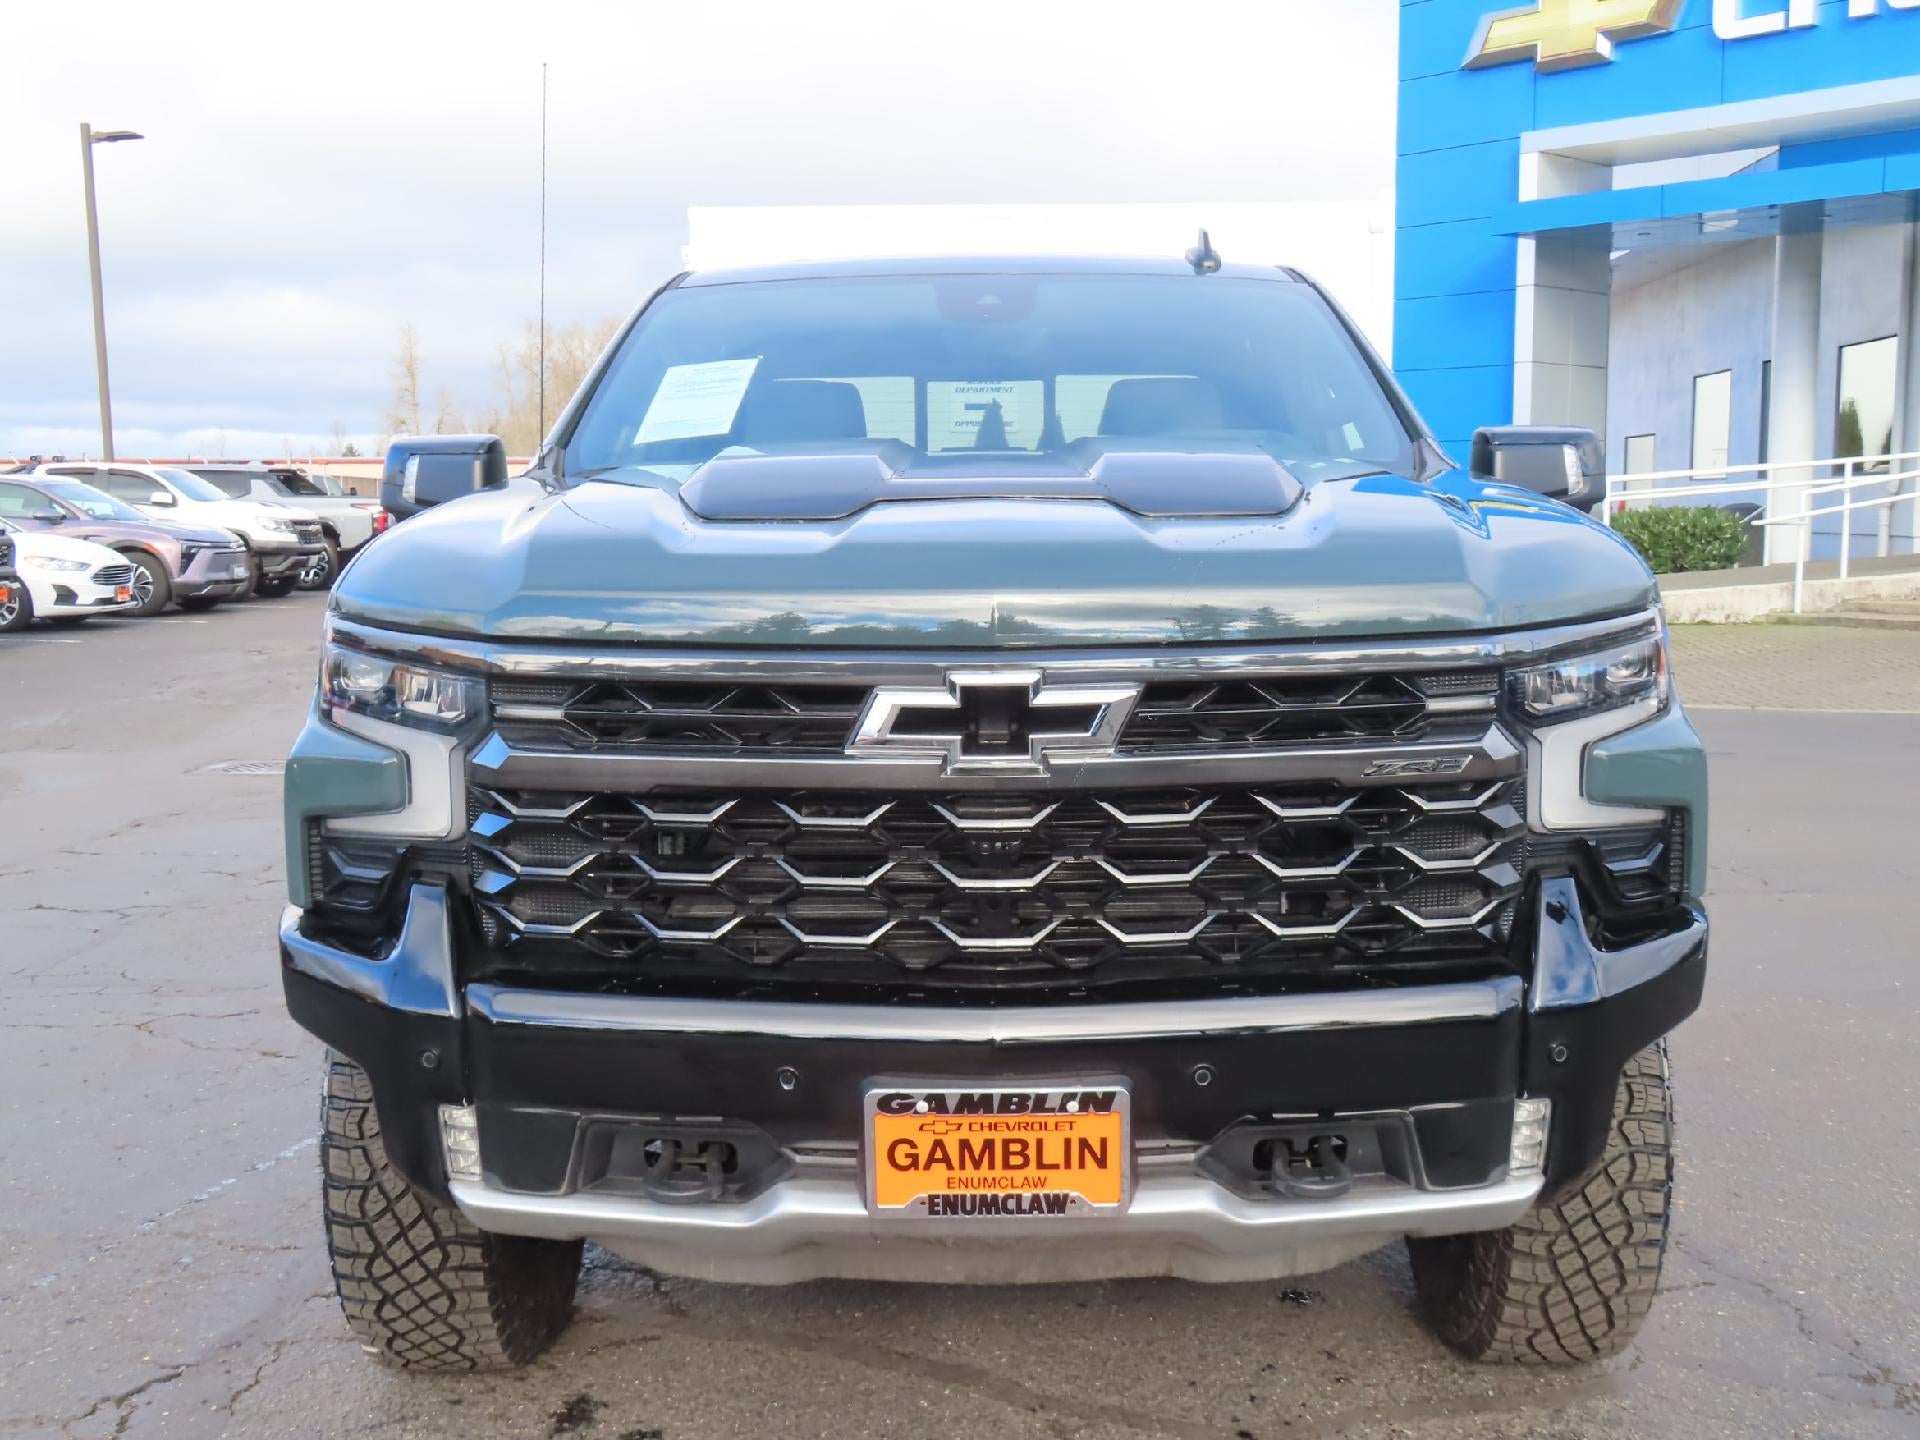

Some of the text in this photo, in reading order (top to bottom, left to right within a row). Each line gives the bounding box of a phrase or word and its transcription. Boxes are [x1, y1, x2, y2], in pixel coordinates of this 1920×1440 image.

[876, 1091, 1117, 1115] GAMBLIN
[968, 1120, 1077, 1132] CHEVROLET
[886, 1137, 1109, 1172] GAMBLIN
[946, 1176, 1048, 1190] ENUMCLAW
[927, 1193, 1070, 1216] ENUMCLAW
